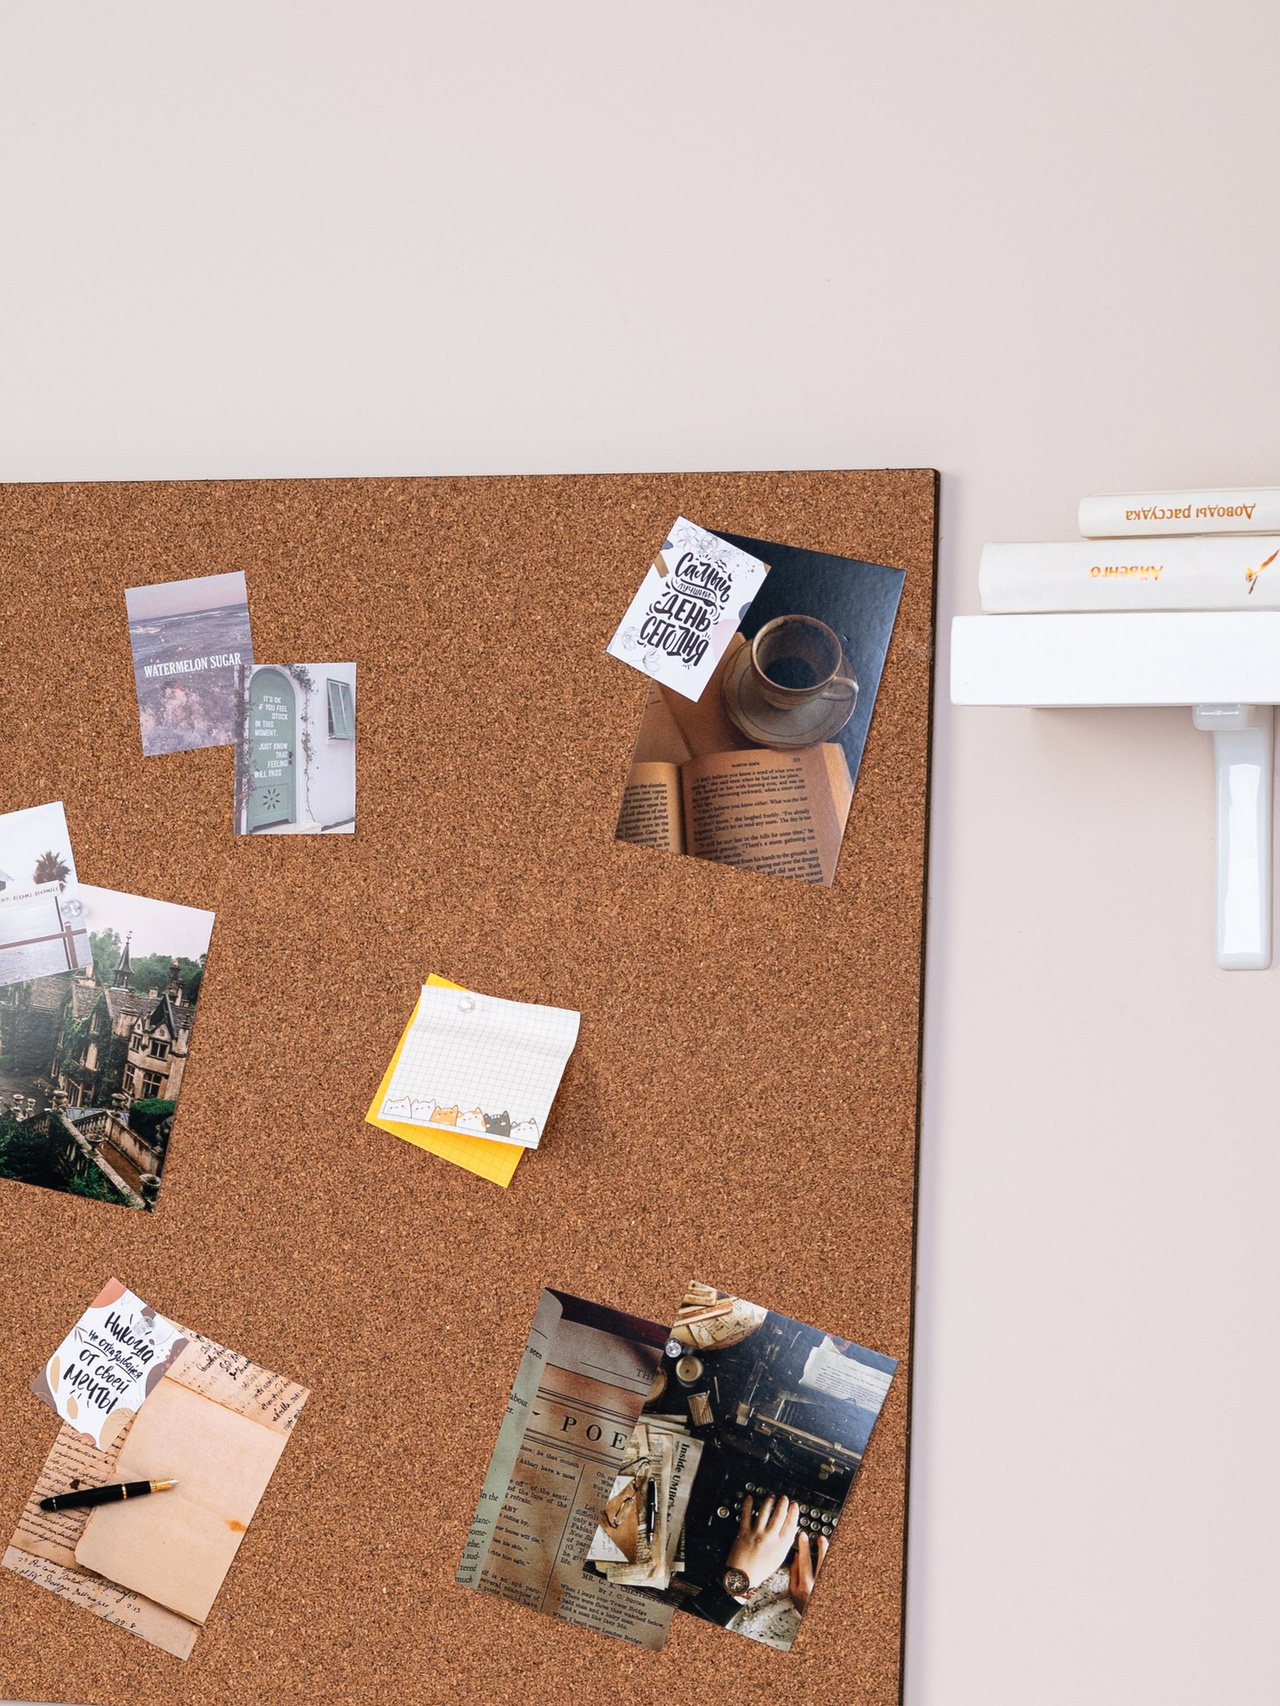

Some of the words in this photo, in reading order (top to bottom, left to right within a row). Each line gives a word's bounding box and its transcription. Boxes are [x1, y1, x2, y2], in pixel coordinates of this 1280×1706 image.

[1125, 504, 1191, 522] рассудка
[1196, 503, 1256, 520] Доводы
[1089, 565, 1163, 581] Айвенго
[654, 593, 711, 632] ДЕНЬ
[640, 615, 710, 667] СЕГОДНЯ
[143, 657, 208, 678] WATERMELON
[209, 652, 241, 669] SUGAR
[276, 705, 288, 713] FEEL
[560, 1415, 628, 1451] POE
[675, 1443, 689, 1474] Inside
